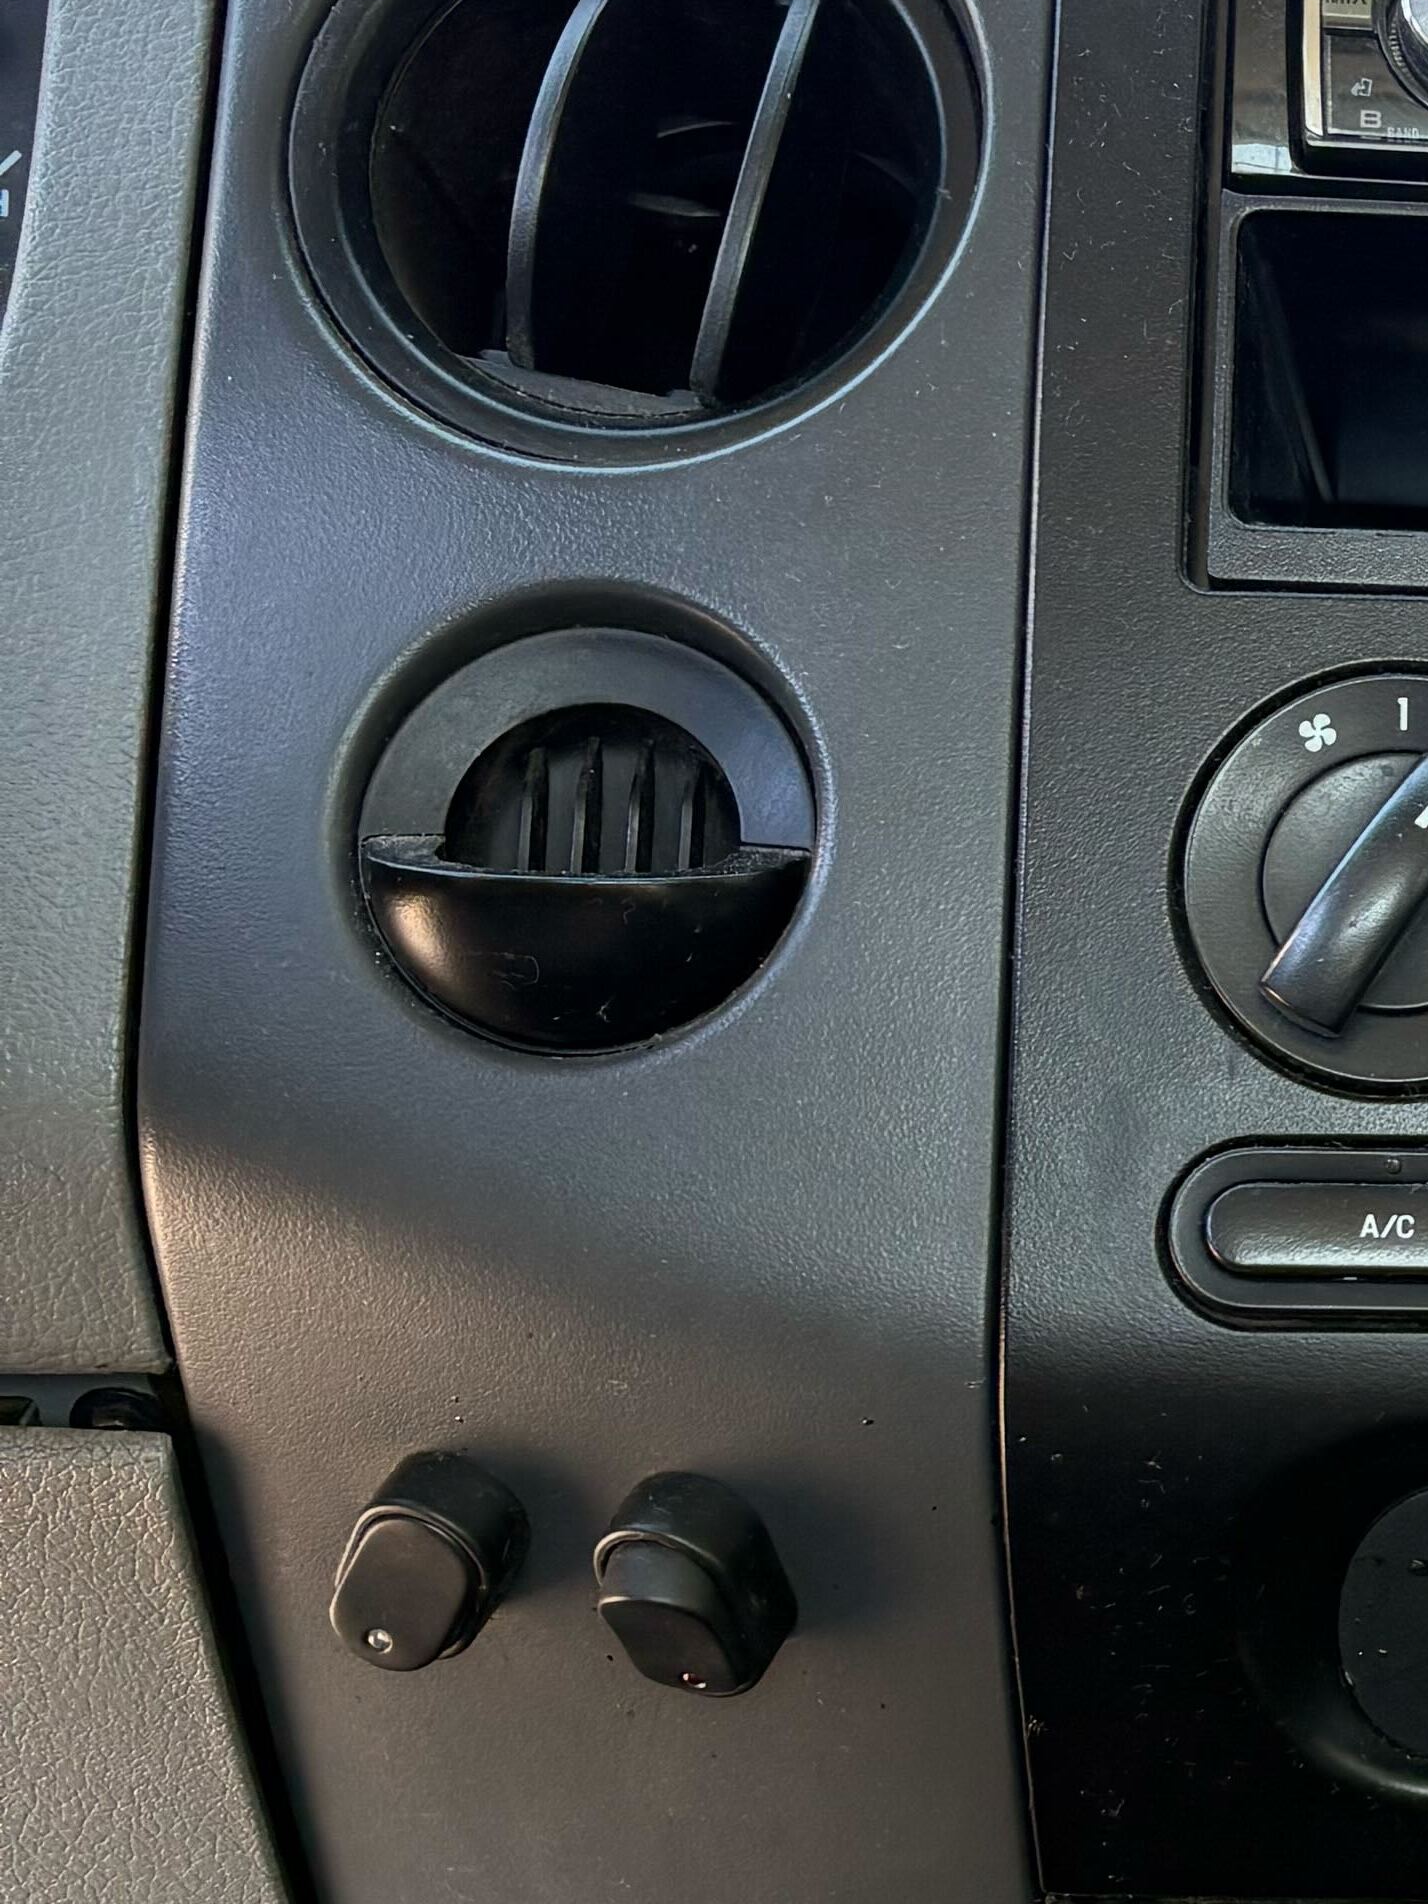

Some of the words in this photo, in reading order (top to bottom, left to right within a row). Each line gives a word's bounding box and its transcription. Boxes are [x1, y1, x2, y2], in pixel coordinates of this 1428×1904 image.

[1360, 109, 1382, 128] B
[1397, 697, 1409, 732] 1
[1359, 1213, 1416, 1239] A/C
